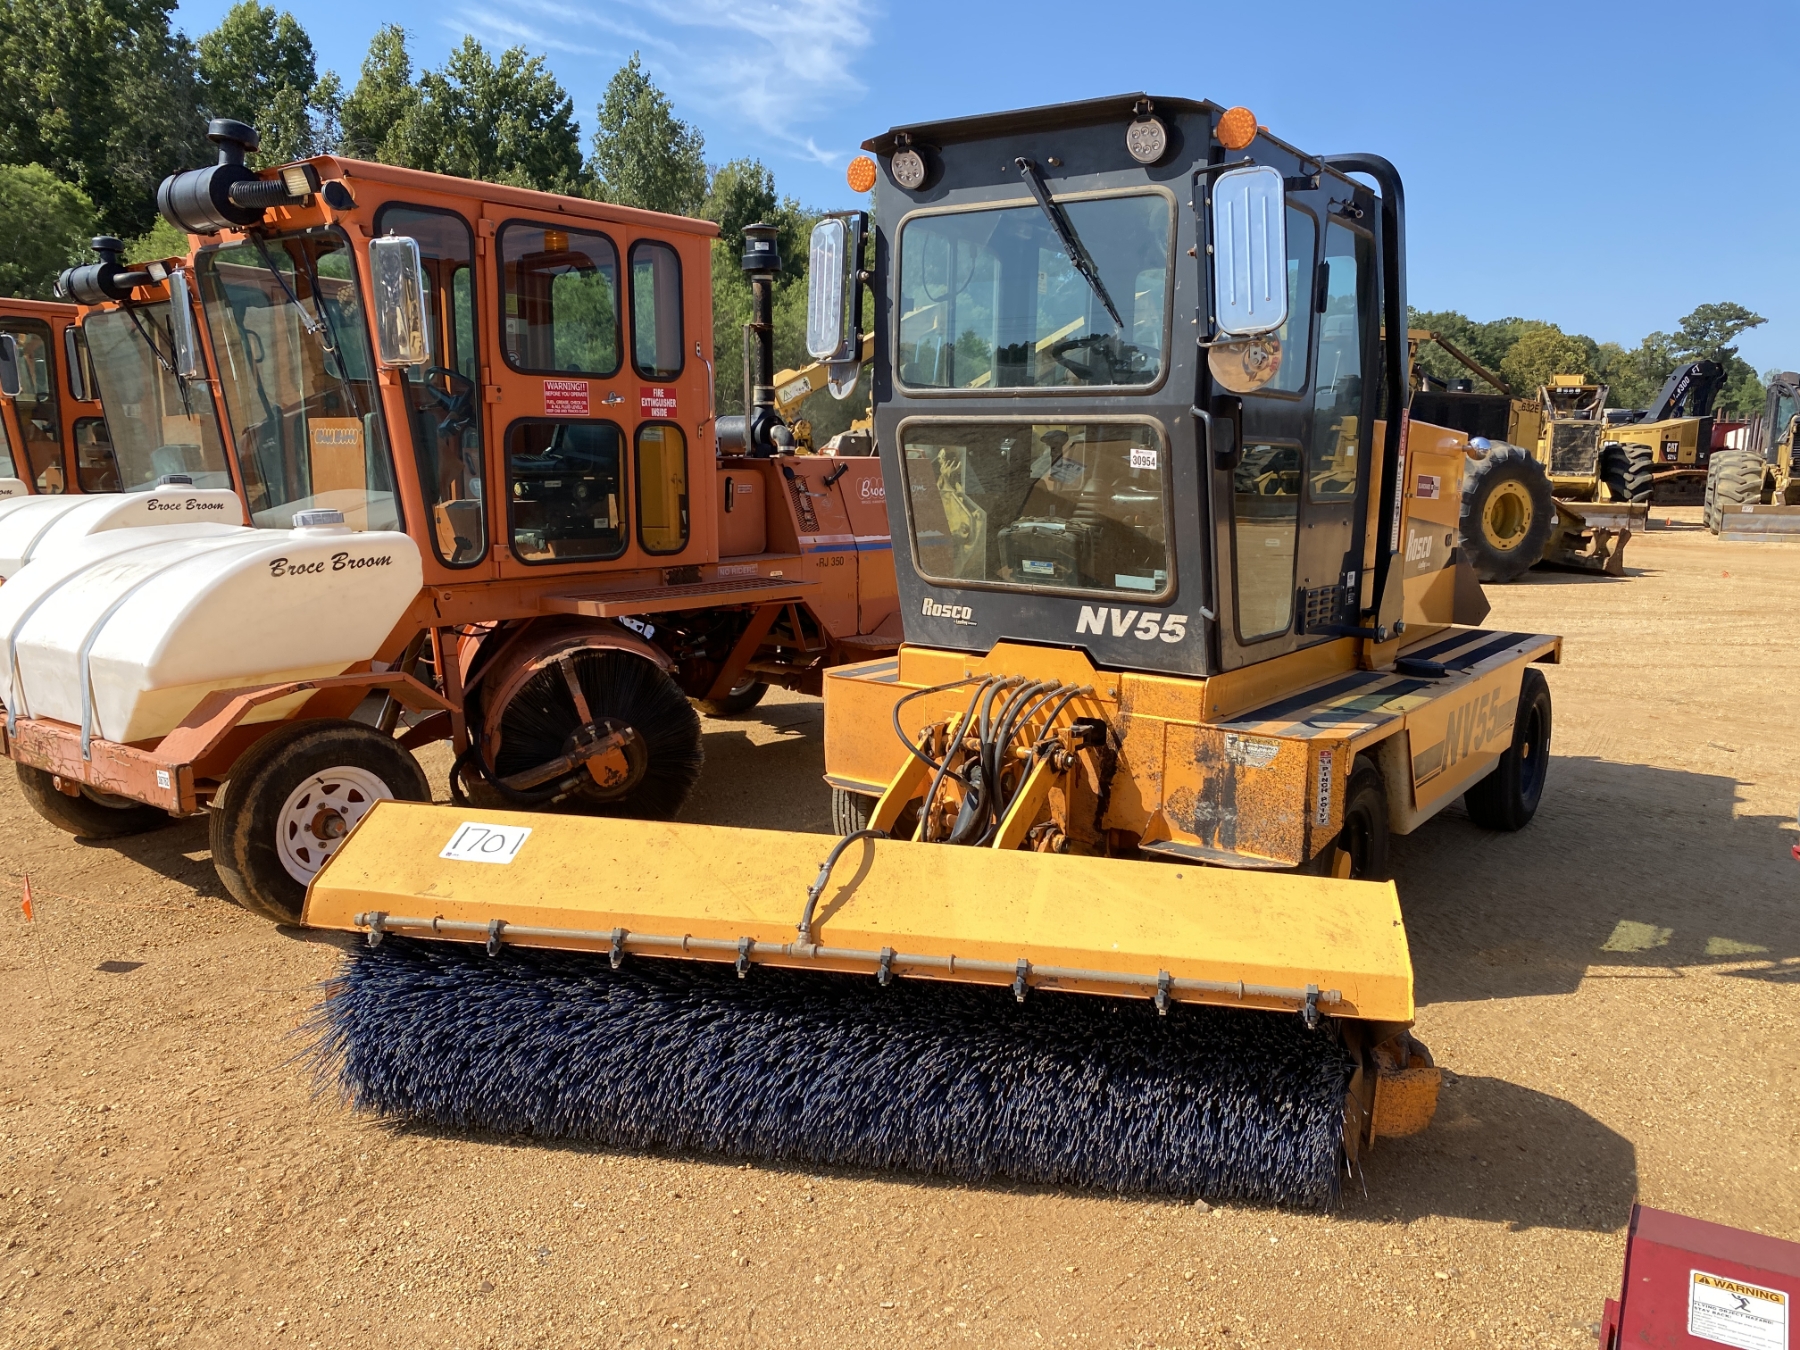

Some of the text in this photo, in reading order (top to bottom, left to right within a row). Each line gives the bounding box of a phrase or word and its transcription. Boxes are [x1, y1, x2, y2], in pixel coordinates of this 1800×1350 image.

[546, 382, 585, 391] WARNING!!
[653, 388, 664, 398] FIRE
[641, 397, 676, 408] EXTINGUISHER
[651, 408, 667, 417] INSIDE
[1666, 442, 1679, 453] CAT
[1132, 455, 1156, 467] 30954
[147, 498, 224, 511] Broce Broom
[1405, 529, 1433, 562] Rosco
[269, 552, 392, 577] Broce Broom
[819, 556, 845, 567] RJ 350
[720, 566, 756, 576] NO RIDERS
[922, 597, 973, 620] Rosco
[1076, 605, 1189, 643] NV55
[1441, 686, 1502, 773] NV55
[1319, 766, 1329, 823] PINCH POINT
[451, 826, 525, 855] 1701
[1714, 1279, 1780, 1302] WARNING
